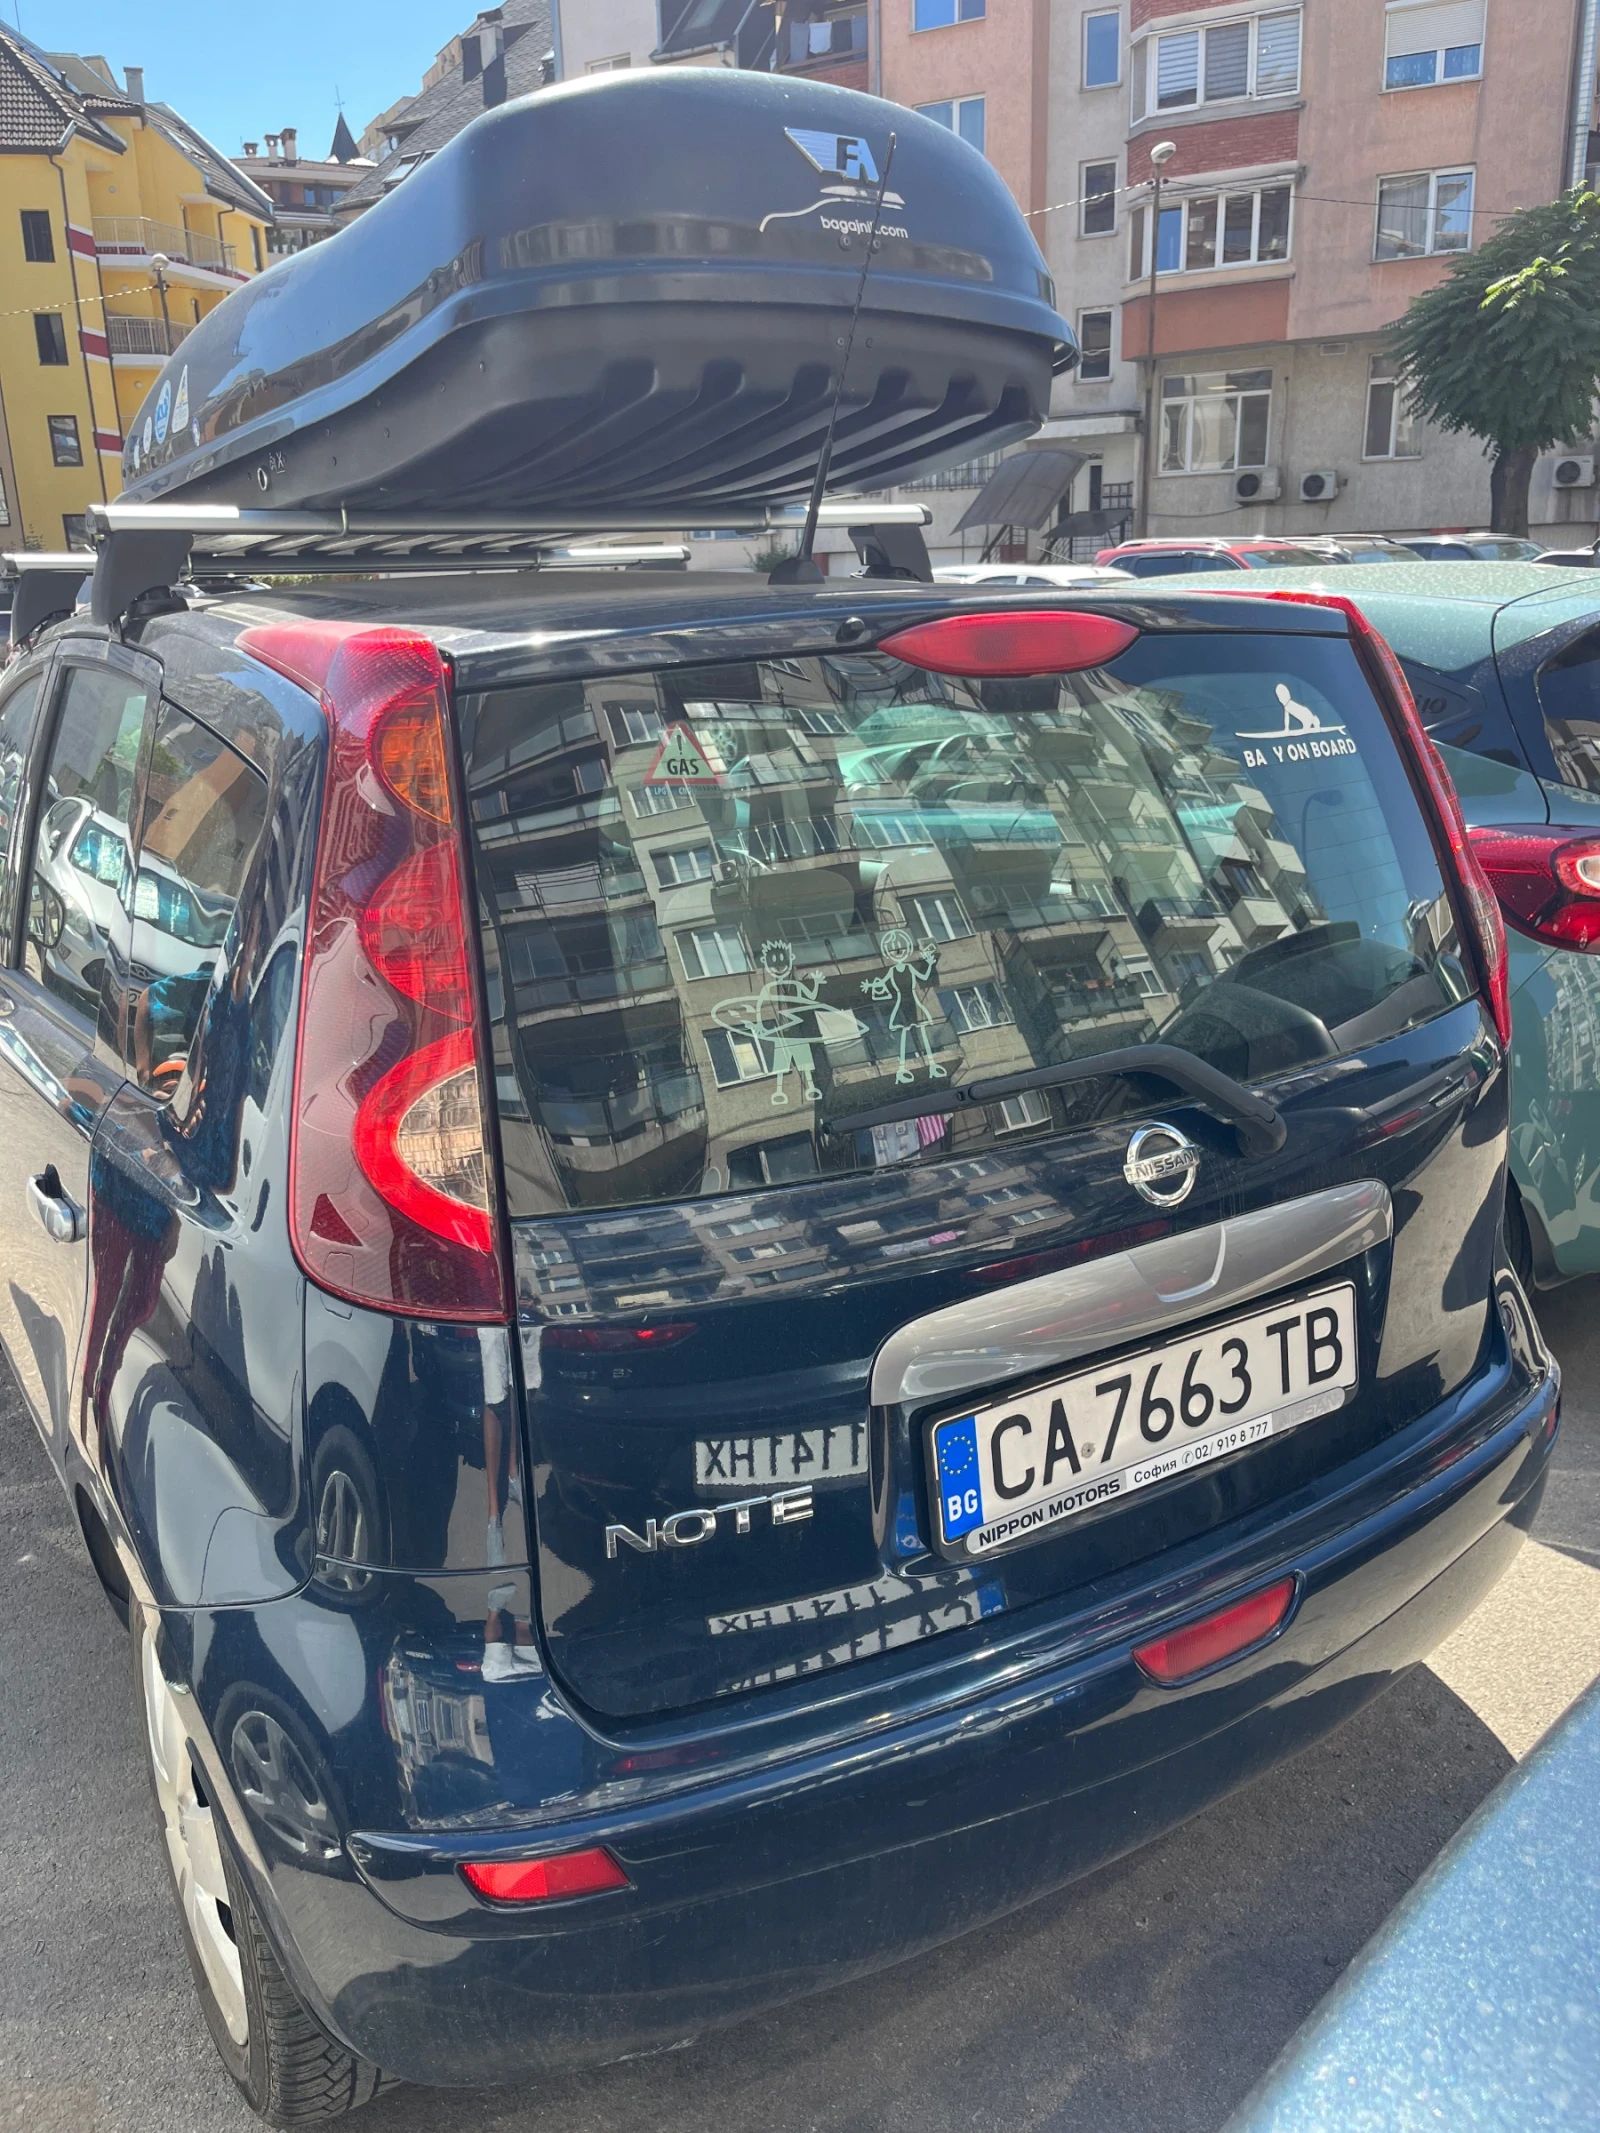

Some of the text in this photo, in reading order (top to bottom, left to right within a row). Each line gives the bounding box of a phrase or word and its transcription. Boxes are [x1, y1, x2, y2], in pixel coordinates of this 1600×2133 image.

[667, 758, 699, 776] GAS
[1287, 743, 1310, 761] ON
[1311, 739, 1357, 758] BOARD
[1135, 1151, 1194, 1177] NISSAN
[990, 1307, 1343, 1500] CA 7663 TB
[1134, 1460, 1177, 1483] София
[1217, 1434, 1237, 1451] 919
[1239, 1430, 1246, 1442] 8
[1249, 1421, 1268, 1439] 777
[605, 1484, 814, 1559] NOTE
[947, 1489, 978, 1522] BG
[979, 1479, 1120, 1547] NIPPON MOTORS
